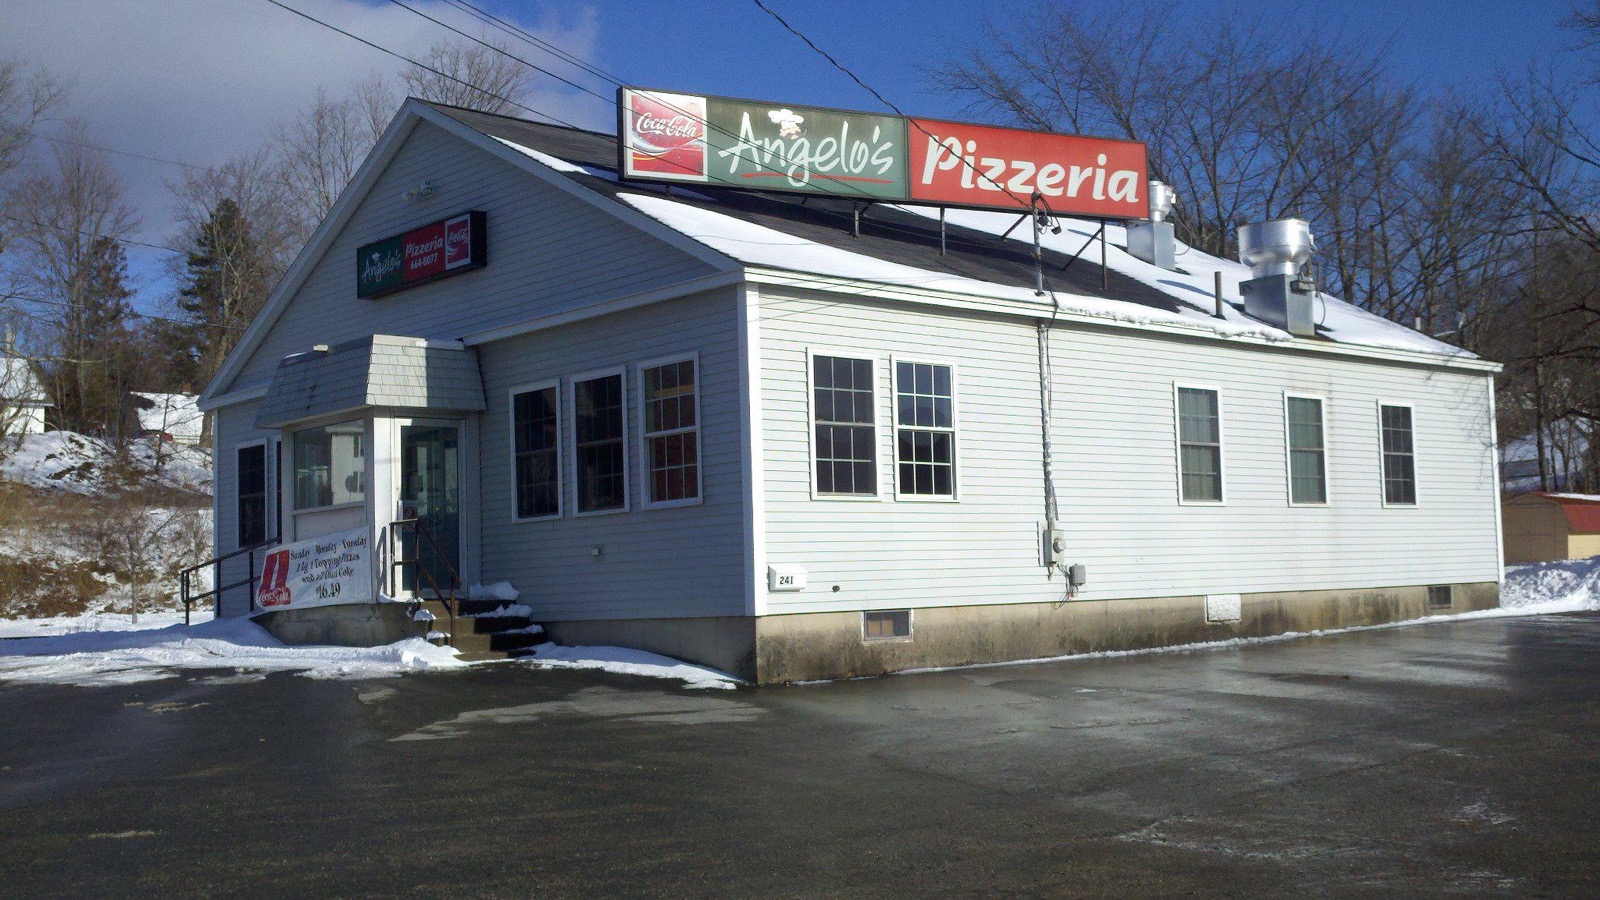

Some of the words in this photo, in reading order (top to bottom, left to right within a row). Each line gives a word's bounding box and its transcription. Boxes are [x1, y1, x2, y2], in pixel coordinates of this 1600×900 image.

[636, 112, 697, 138] Coca-Cola
[718, 111, 894, 187] Angelo's
[921, 134, 1139, 203] Pizzeria
[361, 248, 400, 284] Angelo's
[405, 235, 444, 259] Pizzeria
[342, 537, 367, 548] Tuesday
[780, 575, 794, 585] 241
